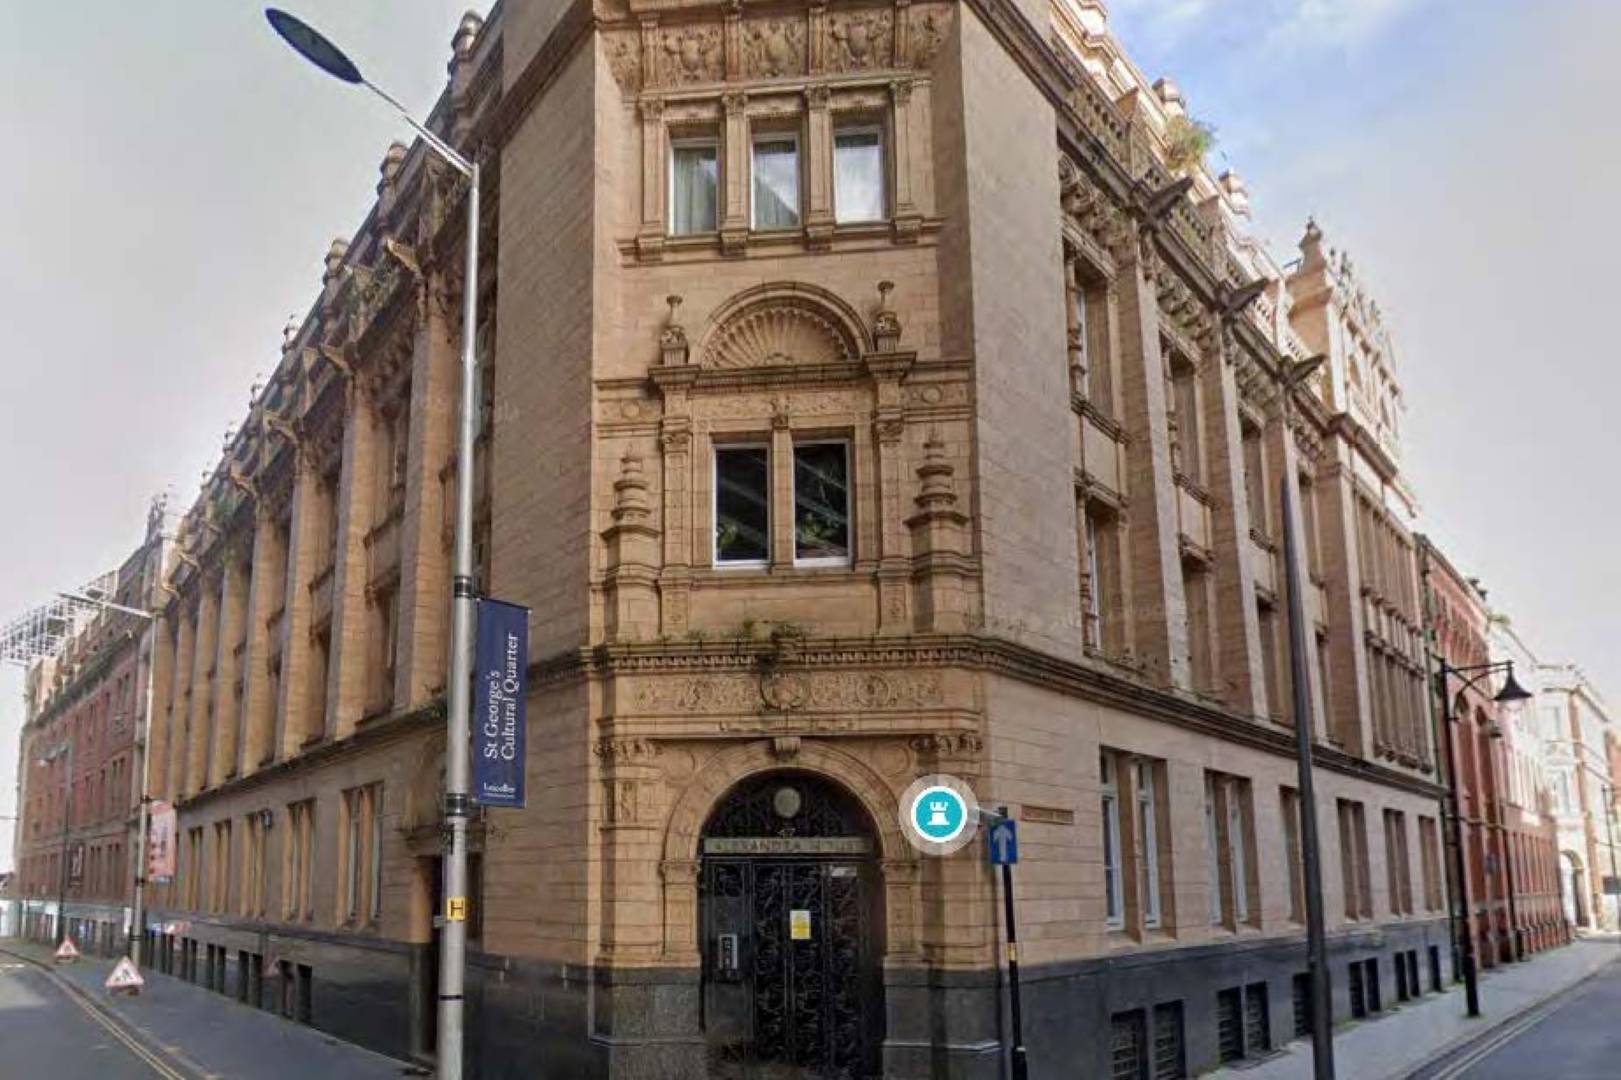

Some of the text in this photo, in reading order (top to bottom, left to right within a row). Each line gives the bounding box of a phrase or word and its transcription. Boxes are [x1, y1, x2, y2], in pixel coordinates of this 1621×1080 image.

[484, 669, 503, 760] St George's
[500, 632, 520, 761] Cultural Quarter
[450, 899, 465, 917] H
